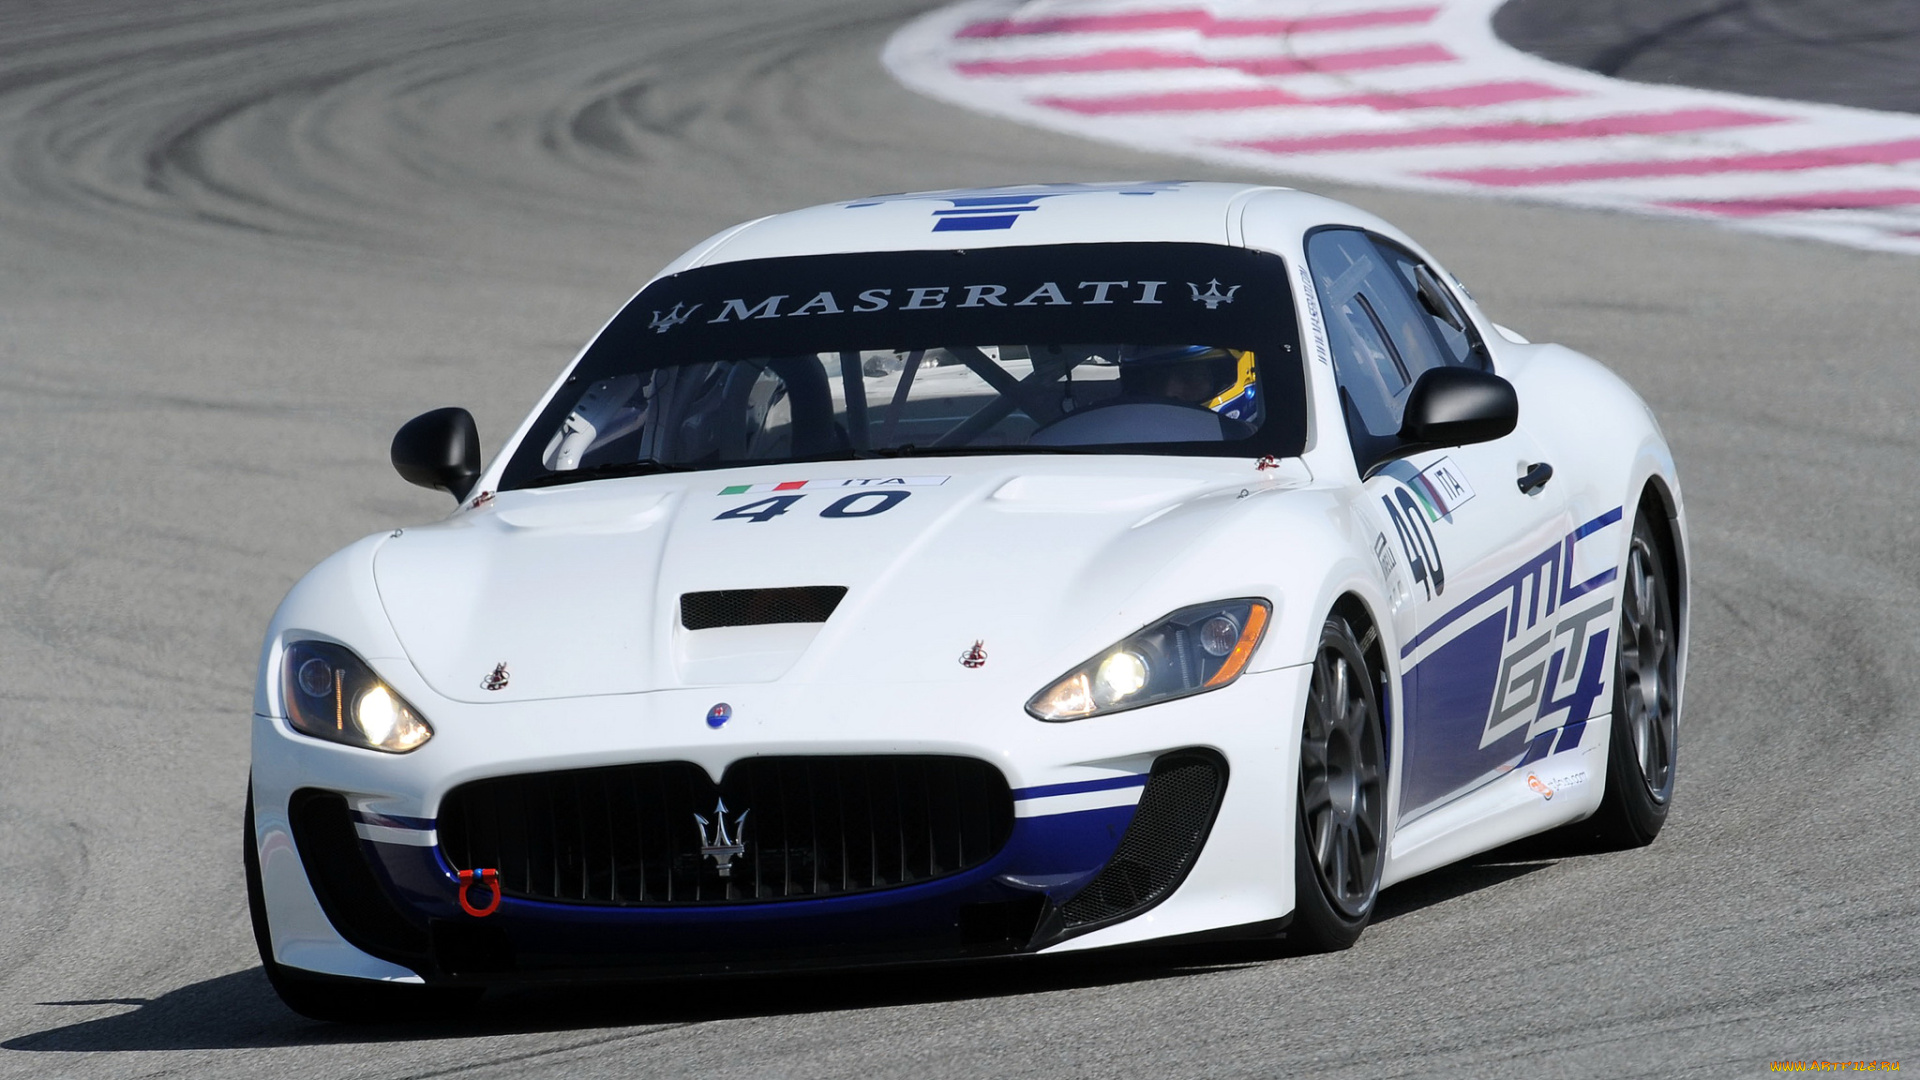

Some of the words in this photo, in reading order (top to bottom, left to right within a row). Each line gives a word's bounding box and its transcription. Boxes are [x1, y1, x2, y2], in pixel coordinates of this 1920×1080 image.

[706, 280, 1168, 325] MASERATI
[841, 477, 906, 486] ITA
[1434, 467, 1465, 500] ITA
[712, 490, 912, 523] 40
[1381, 486, 1445, 602] 40
